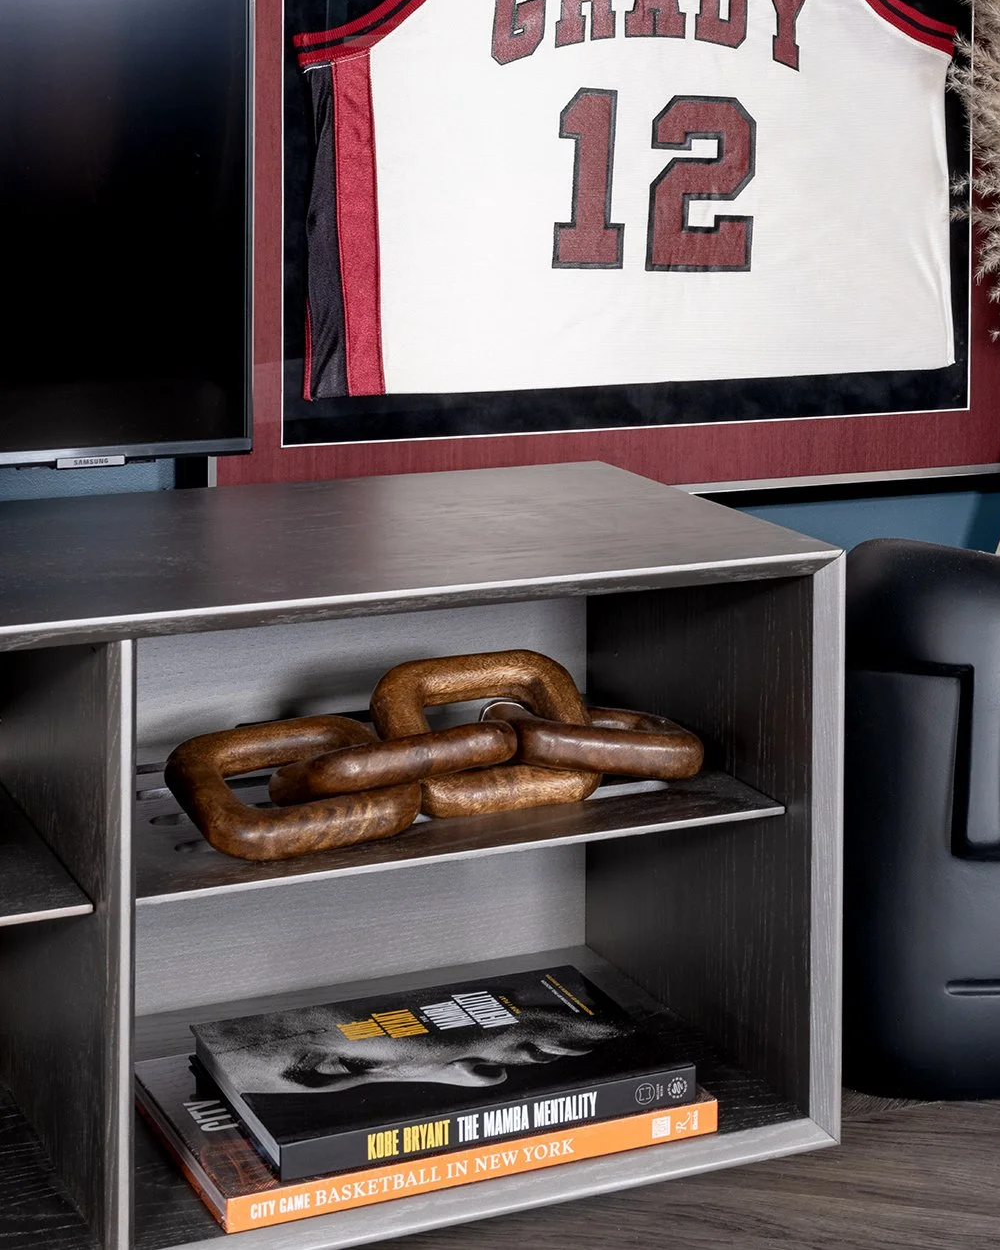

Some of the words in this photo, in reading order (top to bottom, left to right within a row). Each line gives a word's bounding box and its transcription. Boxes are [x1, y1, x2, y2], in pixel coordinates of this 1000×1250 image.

[551, 86, 757, 272] 12
[73, 457, 109, 466] SAMSUNG
[371, 1008, 430, 1039] BRYANT
[420, 1000, 477, 1030] MAMBA
[451, 991, 519, 1029] MENTALITY
[183, 1099, 239, 1132] CITY
[367, 1129, 400, 1161] KOBE
[403, 1119, 450, 1153] BRYANT
[457, 1113, 479, 1143] THE
[484, 1104, 530, 1138] MAMBA
[533, 1091, 597, 1128] MENTALITY
[250, 1200, 276, 1220] CITY
[279, 1193, 311, 1213] GAME
[315, 1166, 442, 1207] BASKETBALL
[446, 1160, 468, 1178] IN
[475, 1149, 519, 1173] NEW
[522, 1138, 575, 1163] YORK
